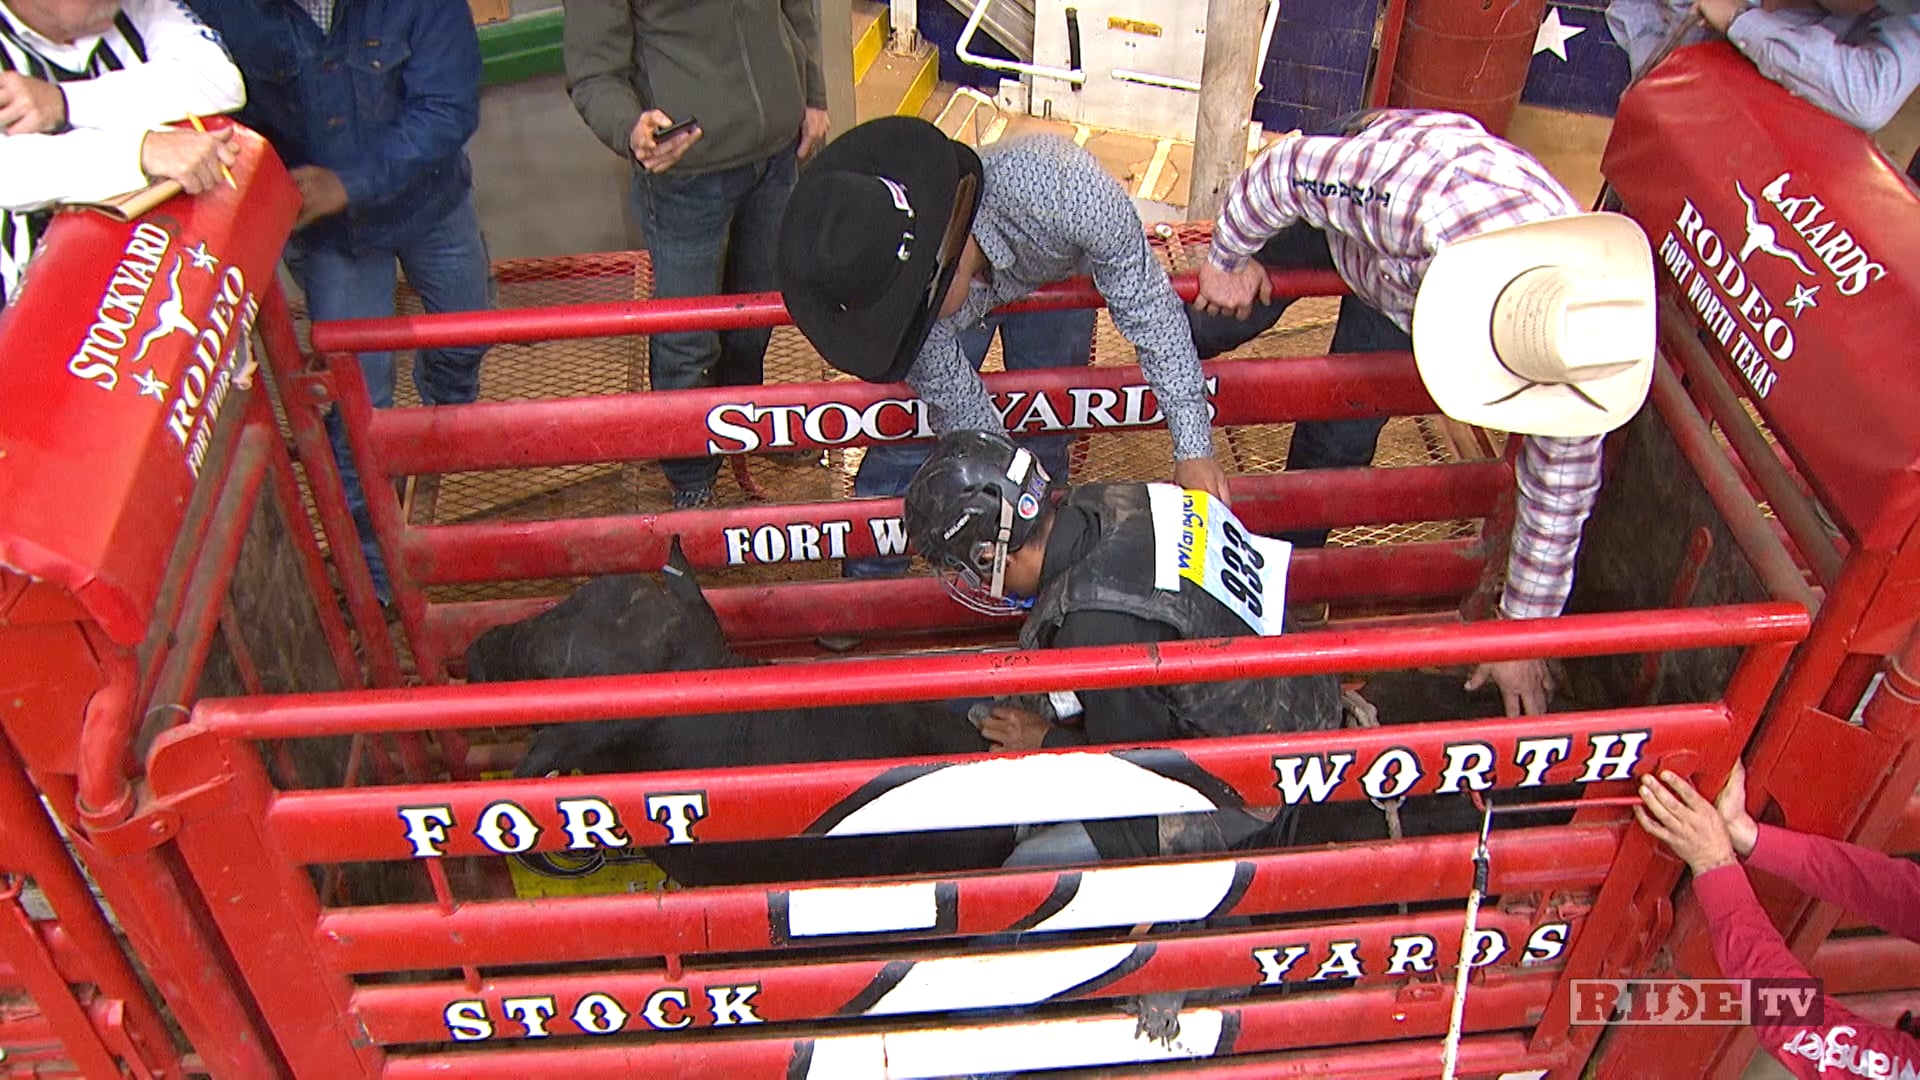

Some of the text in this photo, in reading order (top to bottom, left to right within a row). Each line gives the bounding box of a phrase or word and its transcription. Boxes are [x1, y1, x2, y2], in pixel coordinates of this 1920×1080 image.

[1658, 230, 1779, 399] FORT WORTH TEXAS
[1675, 197, 1796, 361] RODEO
[166, 265, 246, 450] RODEO
[186, 415, 213, 479] FORT
[724, 520, 852, 566] FORT
[1221, 520, 1265, 618] 933
[397, 727, 1652, 857] FORT WORTH
[444, 921, 1571, 1042] STOCK YARDS
